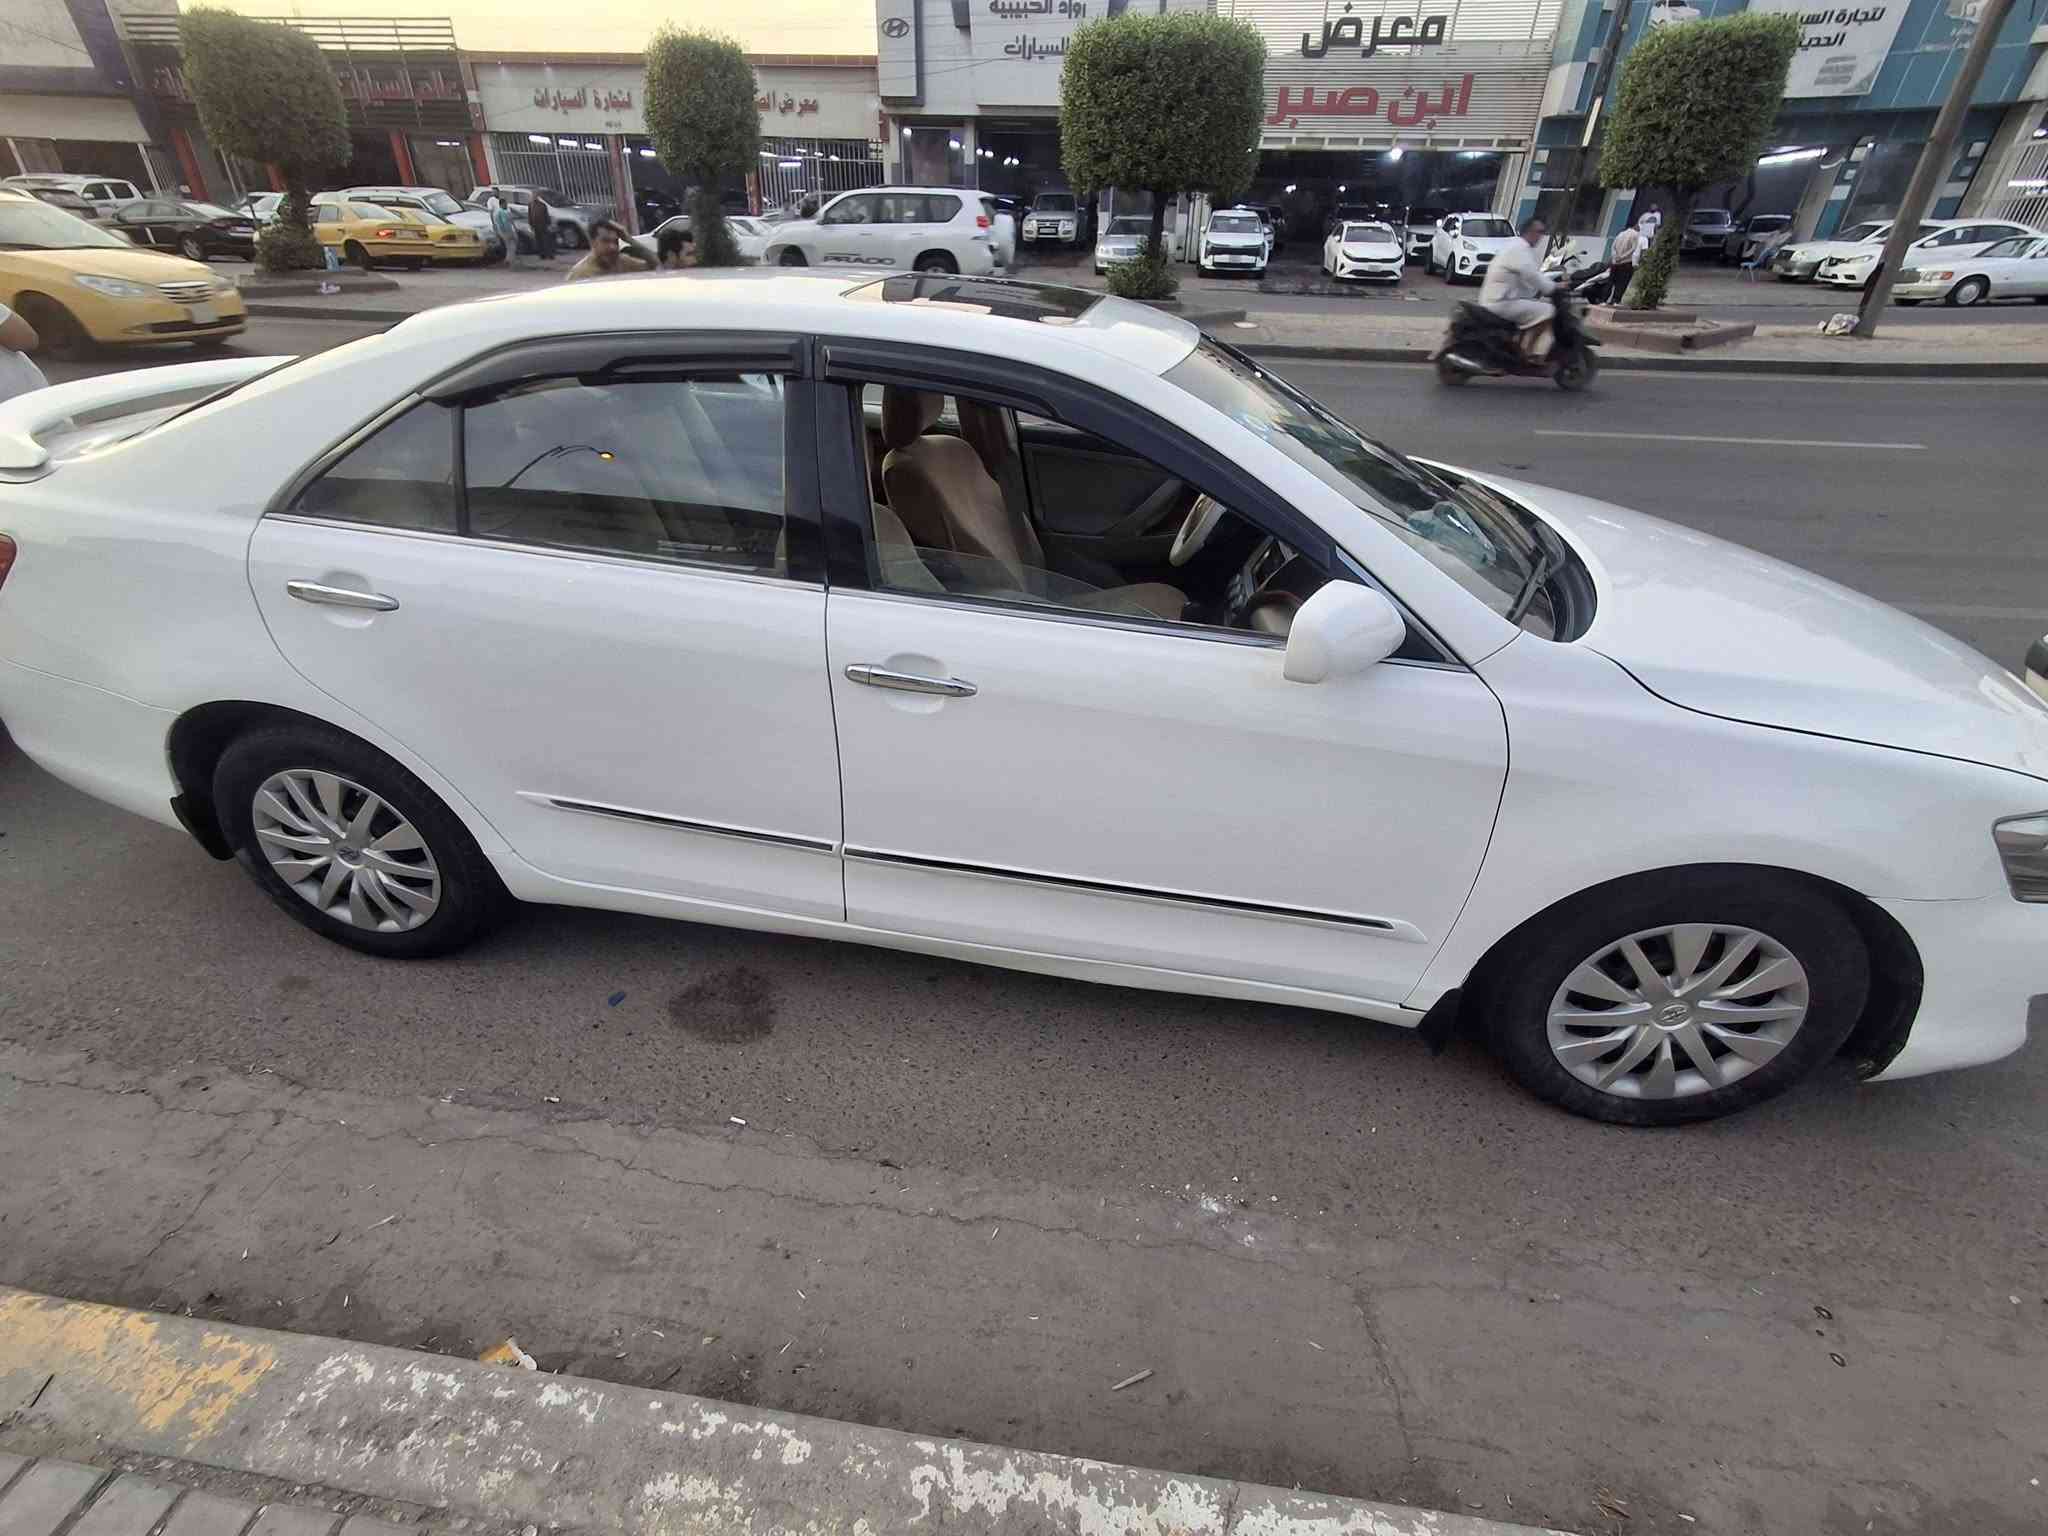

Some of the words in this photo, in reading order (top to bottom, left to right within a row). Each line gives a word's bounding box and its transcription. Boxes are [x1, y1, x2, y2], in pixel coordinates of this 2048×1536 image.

[1836, 7, 1886, 25] لتجارة
[1302, 2, 1447, 58] معرض
[1799, 32, 1846, 50] الحدي
[533, 87, 587, 115] السيارات
[593, 88, 634, 113] لتجارة
[778, 92, 820, 117] معرض
[1264, 86, 1380, 129] صبر
[1388, 72, 1475, 130] ابن
[823, 255, 896, 266] PRADO
